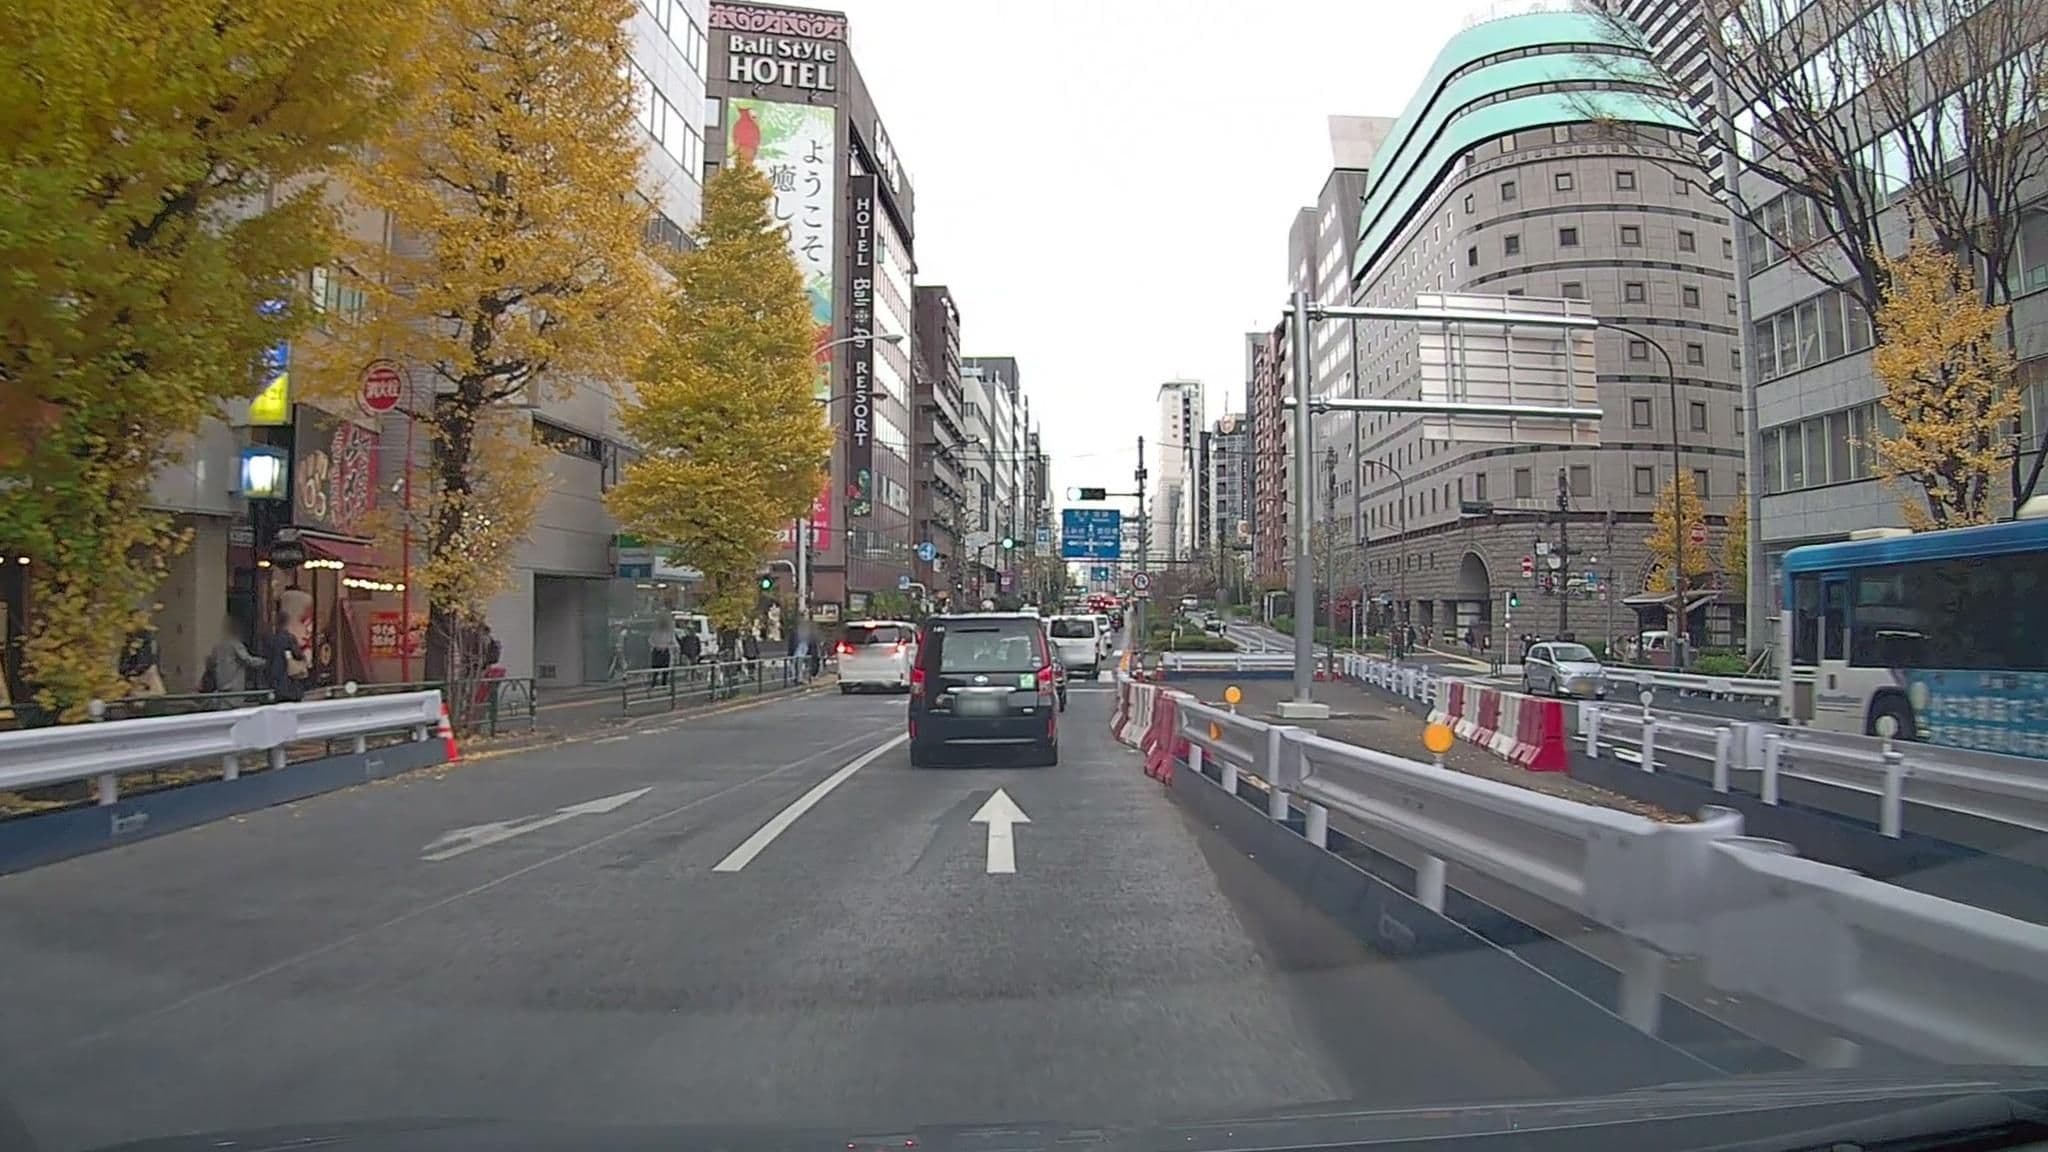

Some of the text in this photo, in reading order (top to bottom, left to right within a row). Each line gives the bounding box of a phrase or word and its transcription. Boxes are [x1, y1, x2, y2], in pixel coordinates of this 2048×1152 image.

[729, 35, 836, 62] Bali Style
[728, 55, 835, 91] HOTEL
[856, 198, 870, 266] HOTEL
[853, 278, 871, 306] Bali
[854, 361, 869, 447] RESORT
